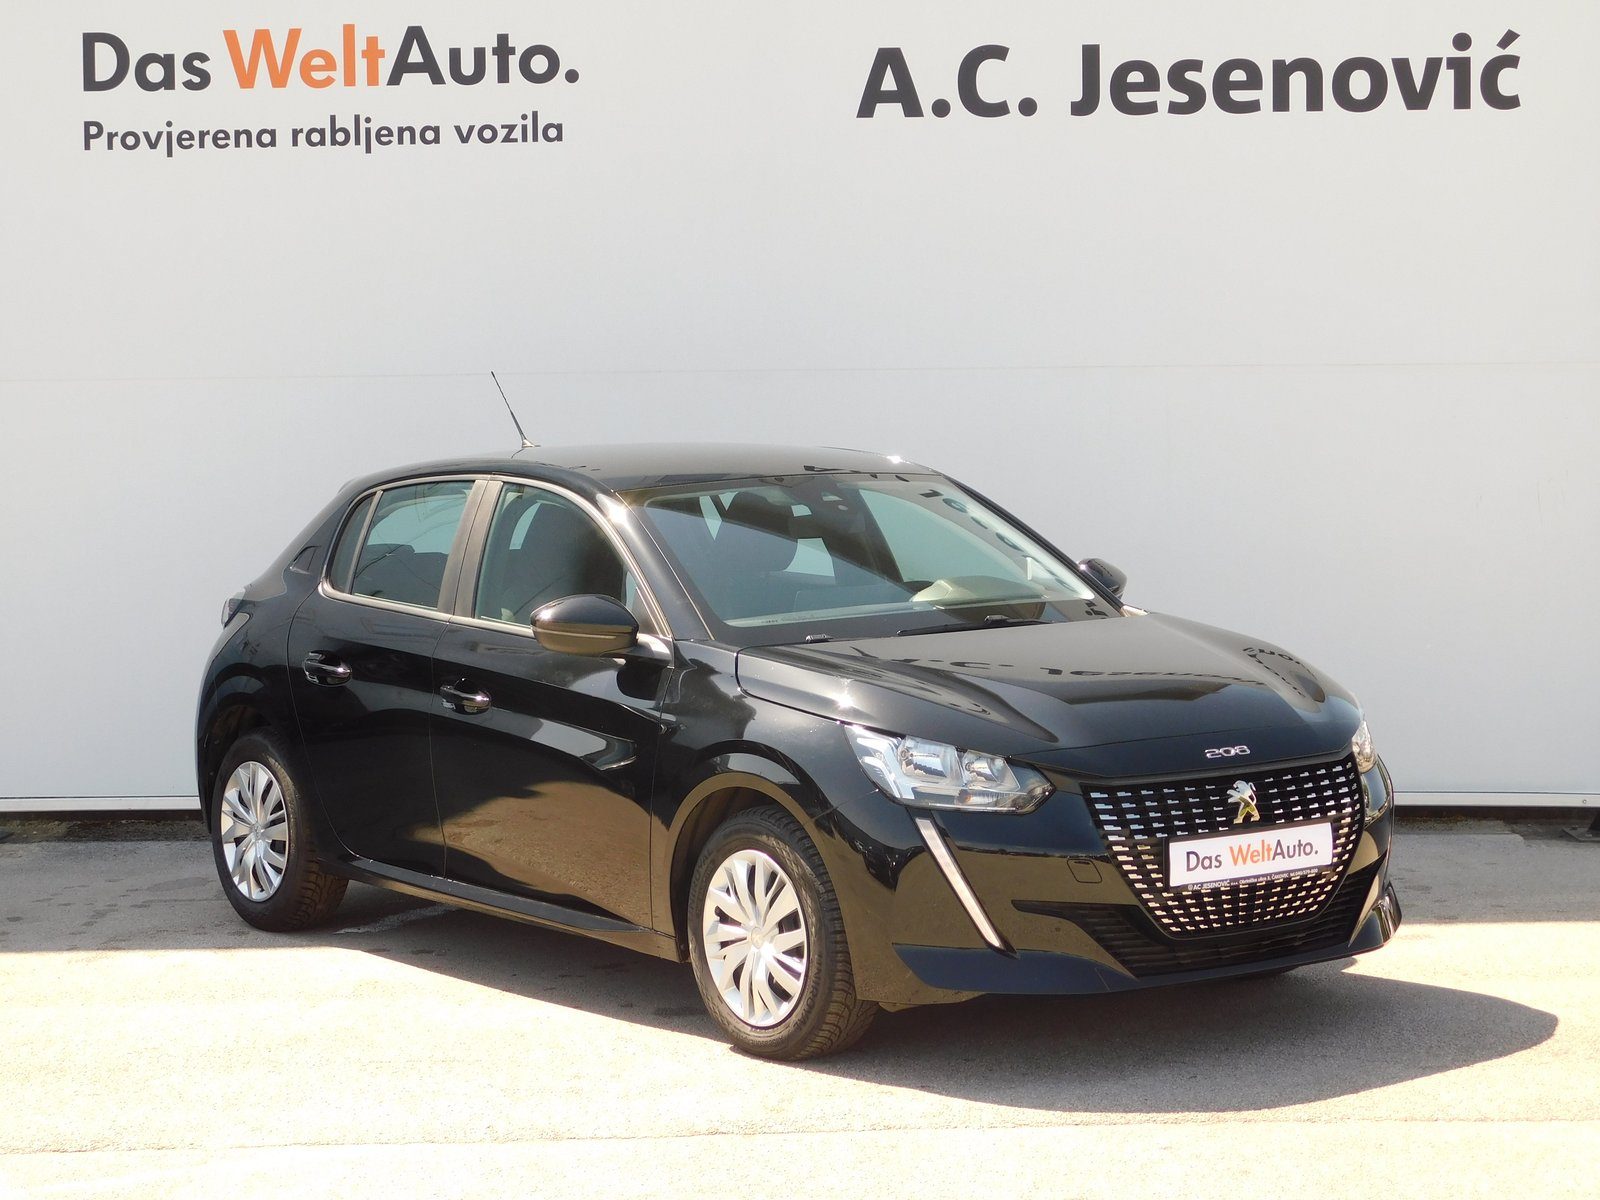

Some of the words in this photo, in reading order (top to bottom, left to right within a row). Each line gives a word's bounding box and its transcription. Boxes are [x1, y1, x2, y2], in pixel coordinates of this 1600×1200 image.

[82, 32, 211, 92] Das
[223, 24, 579, 89] WeltAuto.
[856, 45, 1037, 118] A.C.
[1071, 29, 1521, 116] Jesenović
[84, 121, 276, 157] Provjerena
[292, 114, 440, 154] rabljena
[454, 111, 563, 144] vozila
[1205, 745, 1250, 758] 208
[1186, 851, 1222, 872] Das
[1229, 839, 1319, 866] WeltAuto.
